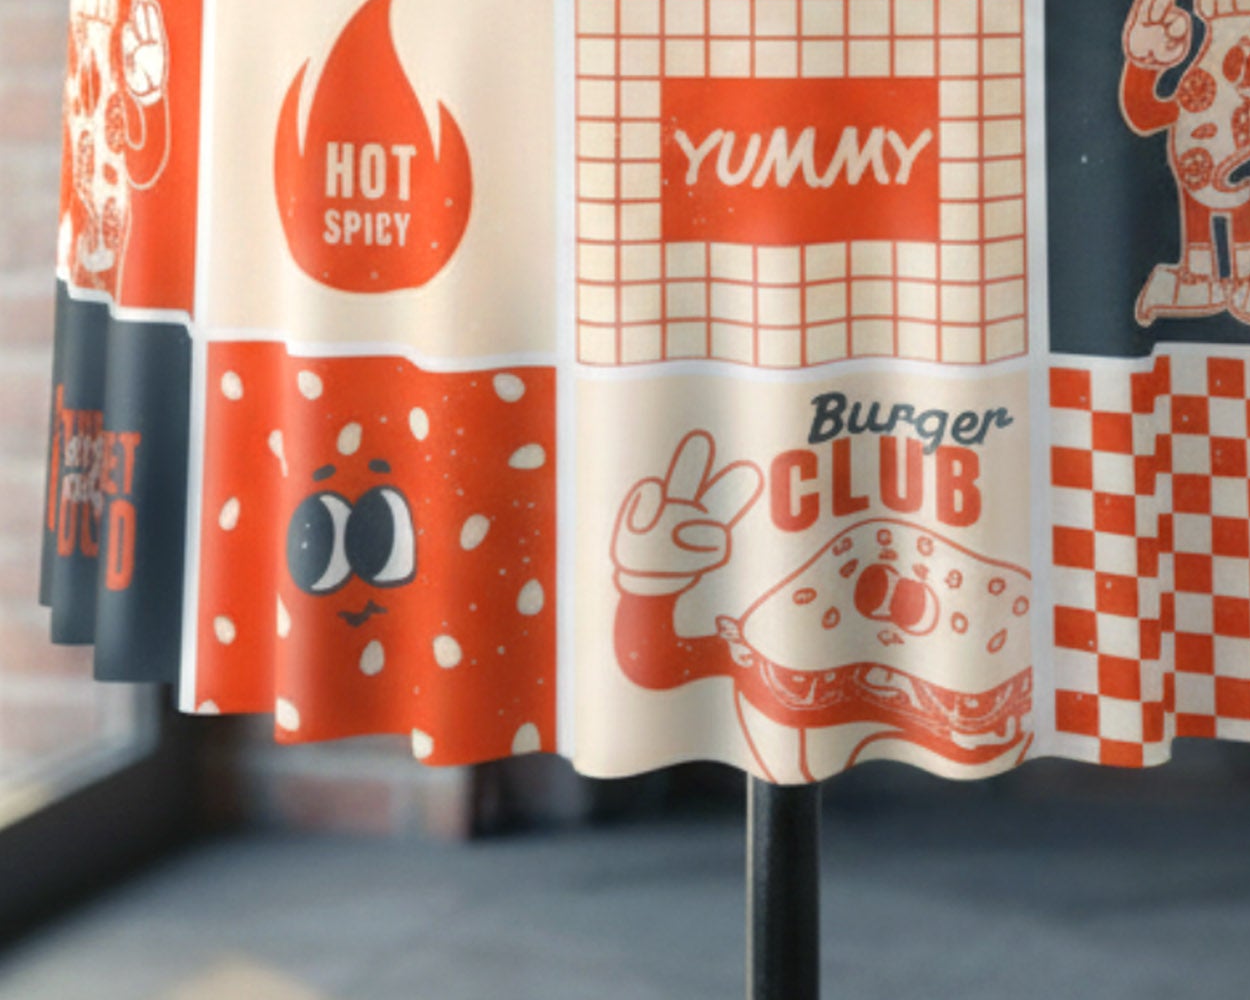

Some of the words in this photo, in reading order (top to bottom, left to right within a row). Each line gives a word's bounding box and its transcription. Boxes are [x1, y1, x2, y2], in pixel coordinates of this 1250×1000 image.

[325, 141, 418, 201] HOT
[673, 126, 933, 188] YUMMY
[323, 208, 411, 247] SPICY
[808, 391, 1014, 456] Burger
[769, 436, 982, 533] CLUB
